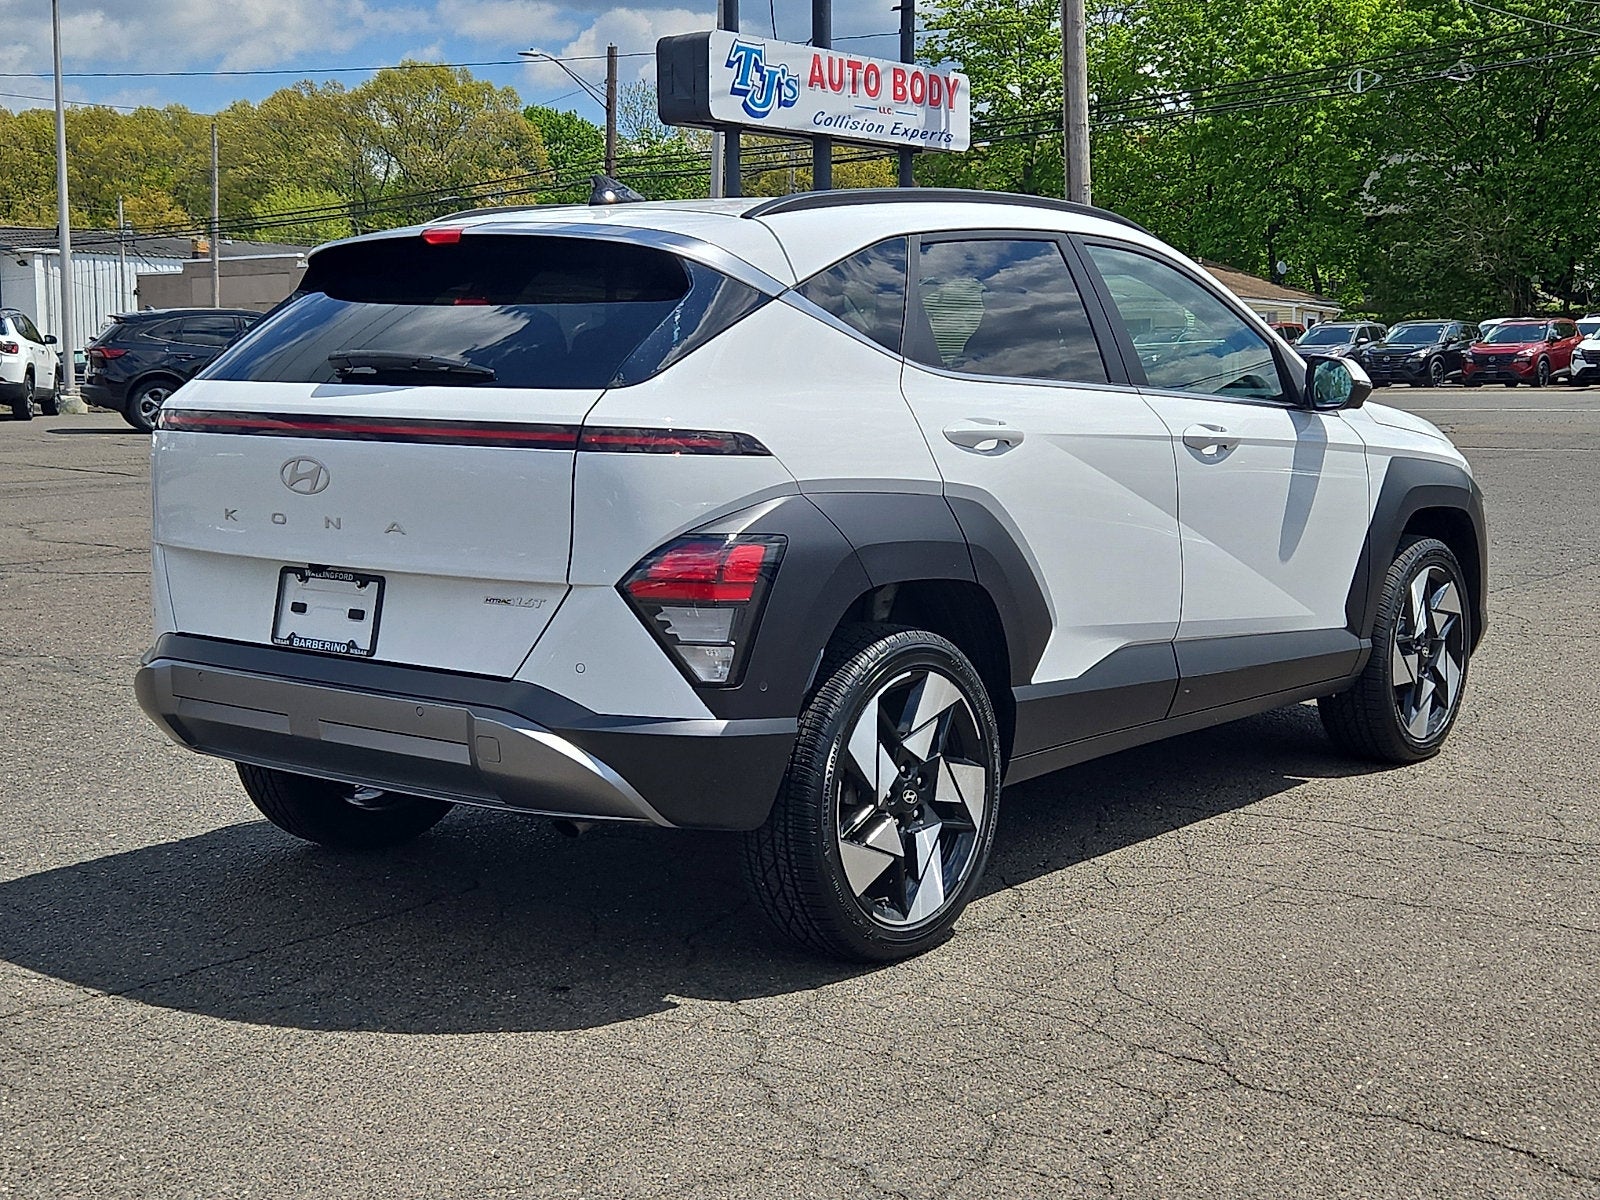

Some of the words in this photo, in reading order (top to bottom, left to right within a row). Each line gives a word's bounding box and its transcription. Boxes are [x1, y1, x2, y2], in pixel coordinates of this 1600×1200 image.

[725, 38, 800, 119] TJ's
[808, 53, 881, 98] AUTO
[892, 67, 959, 110] BODY
[813, 110, 885, 134] Collision
[890, 121, 954, 143] Experts
[223, 507, 407, 536] KONA
[304, 569, 354, 581] WALLINGFORD
[293, 637, 348, 653] BARBERINO
